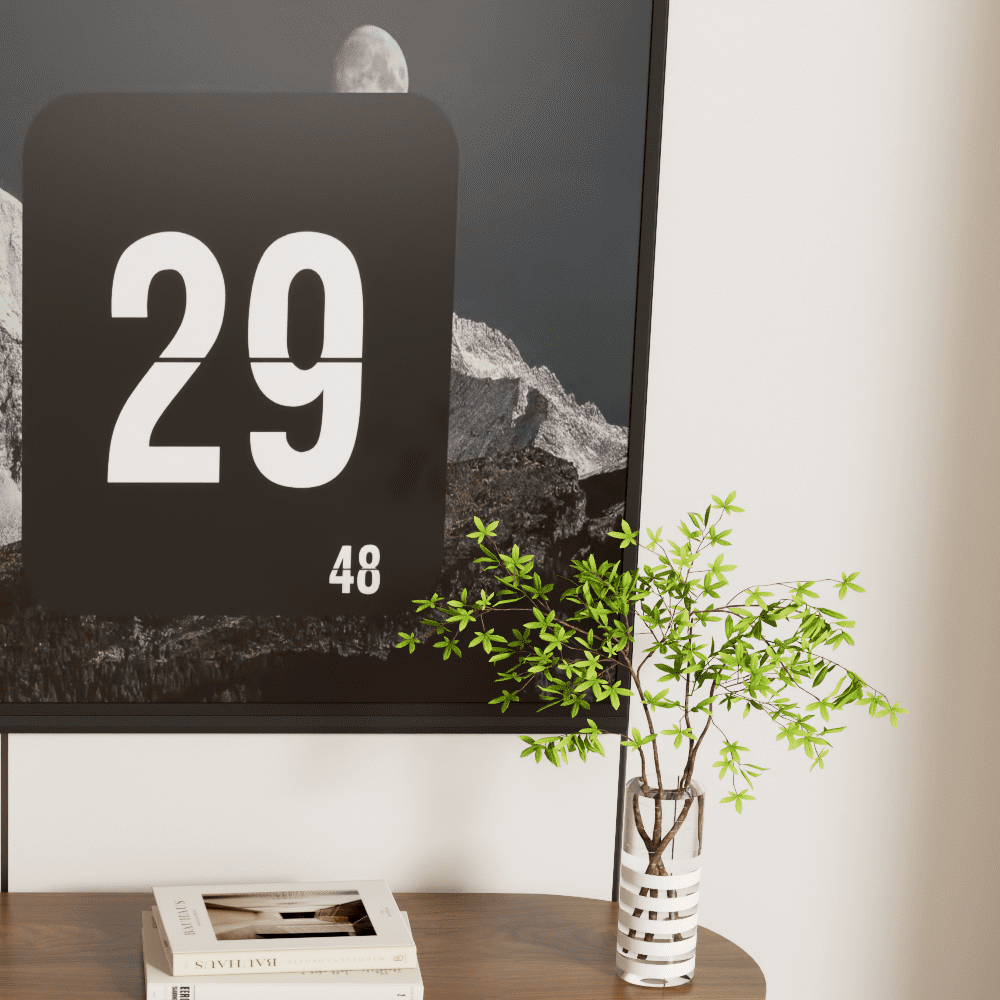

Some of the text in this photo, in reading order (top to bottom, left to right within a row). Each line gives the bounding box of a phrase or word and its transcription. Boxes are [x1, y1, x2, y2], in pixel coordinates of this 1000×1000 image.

[107, 231, 364, 488] 29
[328, 544, 381, 595] 48
[176, 900, 196, 936] BAUHAUS
[195, 957, 277, 970] BAUHAUS
